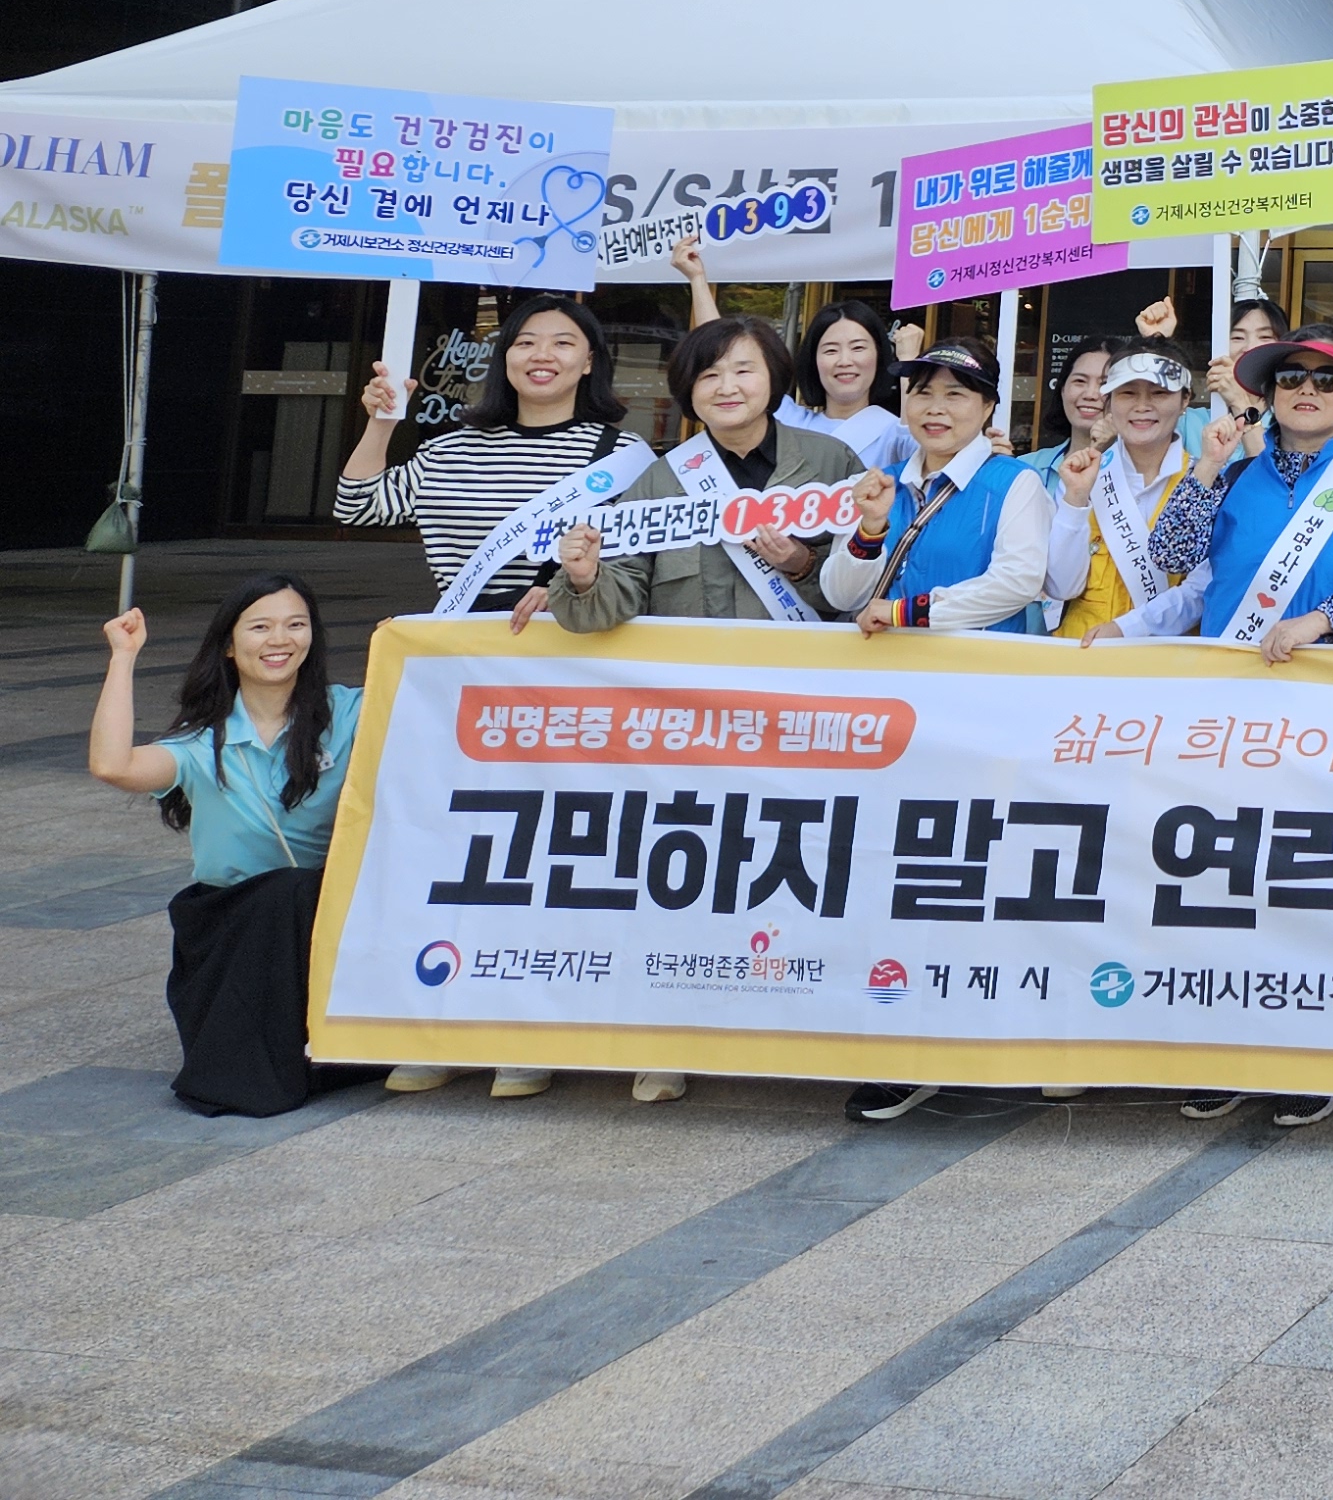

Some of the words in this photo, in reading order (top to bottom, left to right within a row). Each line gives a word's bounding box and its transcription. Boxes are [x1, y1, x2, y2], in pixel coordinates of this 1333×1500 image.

[283, 108, 374, 140] 마음도
[394, 115, 555, 154] 건강검진이
[1103, 108, 1185, 147] 당신의
[1194, 101, 1270, 139] 관심이
[335, 148, 506, 188] 필요합니다.
[914, 171, 963, 210] 내가
[970, 162, 1017, 196] 위로
[1101, 155, 1166, 187] 생명을
[1171, 152, 1214, 180] 살릴
[1221, 149, 1242, 175] 수
[1, 201, 129, 236] ALASKA
[286, 181, 350, 214] 당신
[371, 188, 433, 219] 곁에
[453, 194, 552, 227] 언제나
[715, 187, 819, 240] 1393
[1156, 191, 1313, 222] 거제시정신건강복지센터
[323, 234, 404, 252] 거제시보건소
[407, 239, 514, 260] 정신건강복지센터
[910, 208, 1011, 257] 당신에게
[950, 243, 1093, 284] 거제시정신건강복지센터
[532, 498, 720, 555] #청년상담전화
[733, 486, 855, 535] 1388
[1100, 471, 1120, 508] 거제시
[1112, 511, 1141, 553] 보건소
[485, 521, 528, 562] 보건소
[1268, 514, 1325, 593] 생명사랑
[768, 575, 797, 610] 함께
[475, 704, 615, 748] 생명존중
[622, 707, 768, 752] 생명사랑
[777, 708, 890, 753] 캠페인
[1053, 712, 1164, 765] 삶의
[427, 789, 860, 919] 고민하지
[891, 797, 1110, 924] 말고
[470, 949, 613, 983] 보건복지부
[645, 951, 825, 983] 한국생명존중희망재단
[650, 981, 675, 990] KOREA
[676, 982, 723, 992] FOUNDATION
[724, 984, 739, 992] FOR
[741, 984, 768, 994] SUICIDE
[770, 985, 814, 995] PREVENTION
